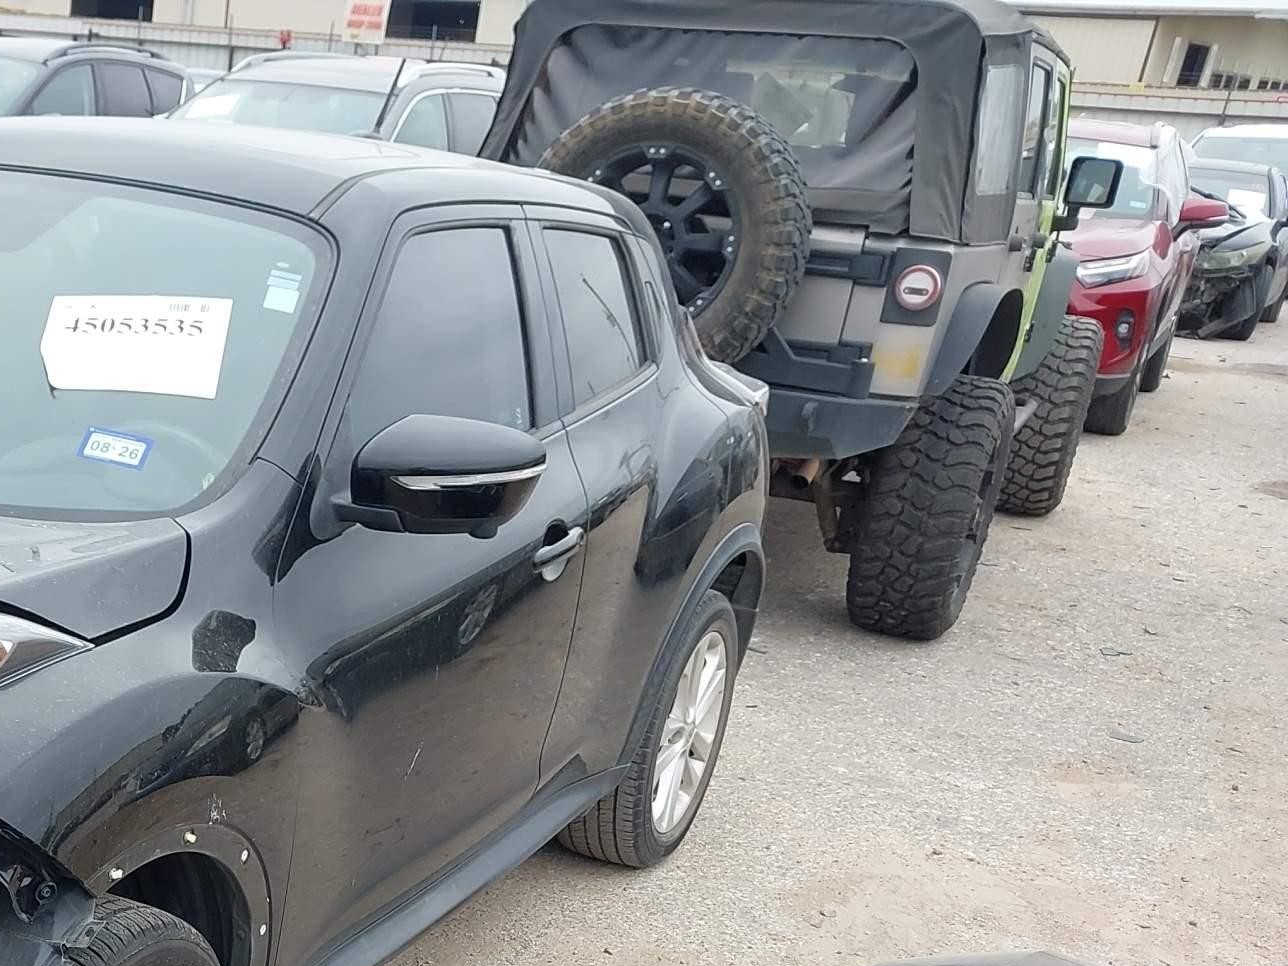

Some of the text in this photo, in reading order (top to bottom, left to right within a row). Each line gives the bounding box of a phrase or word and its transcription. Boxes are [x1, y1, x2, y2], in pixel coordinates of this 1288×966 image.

[65, 317, 204, 336] 45053535
[90, 440, 140, 460] 08 26
